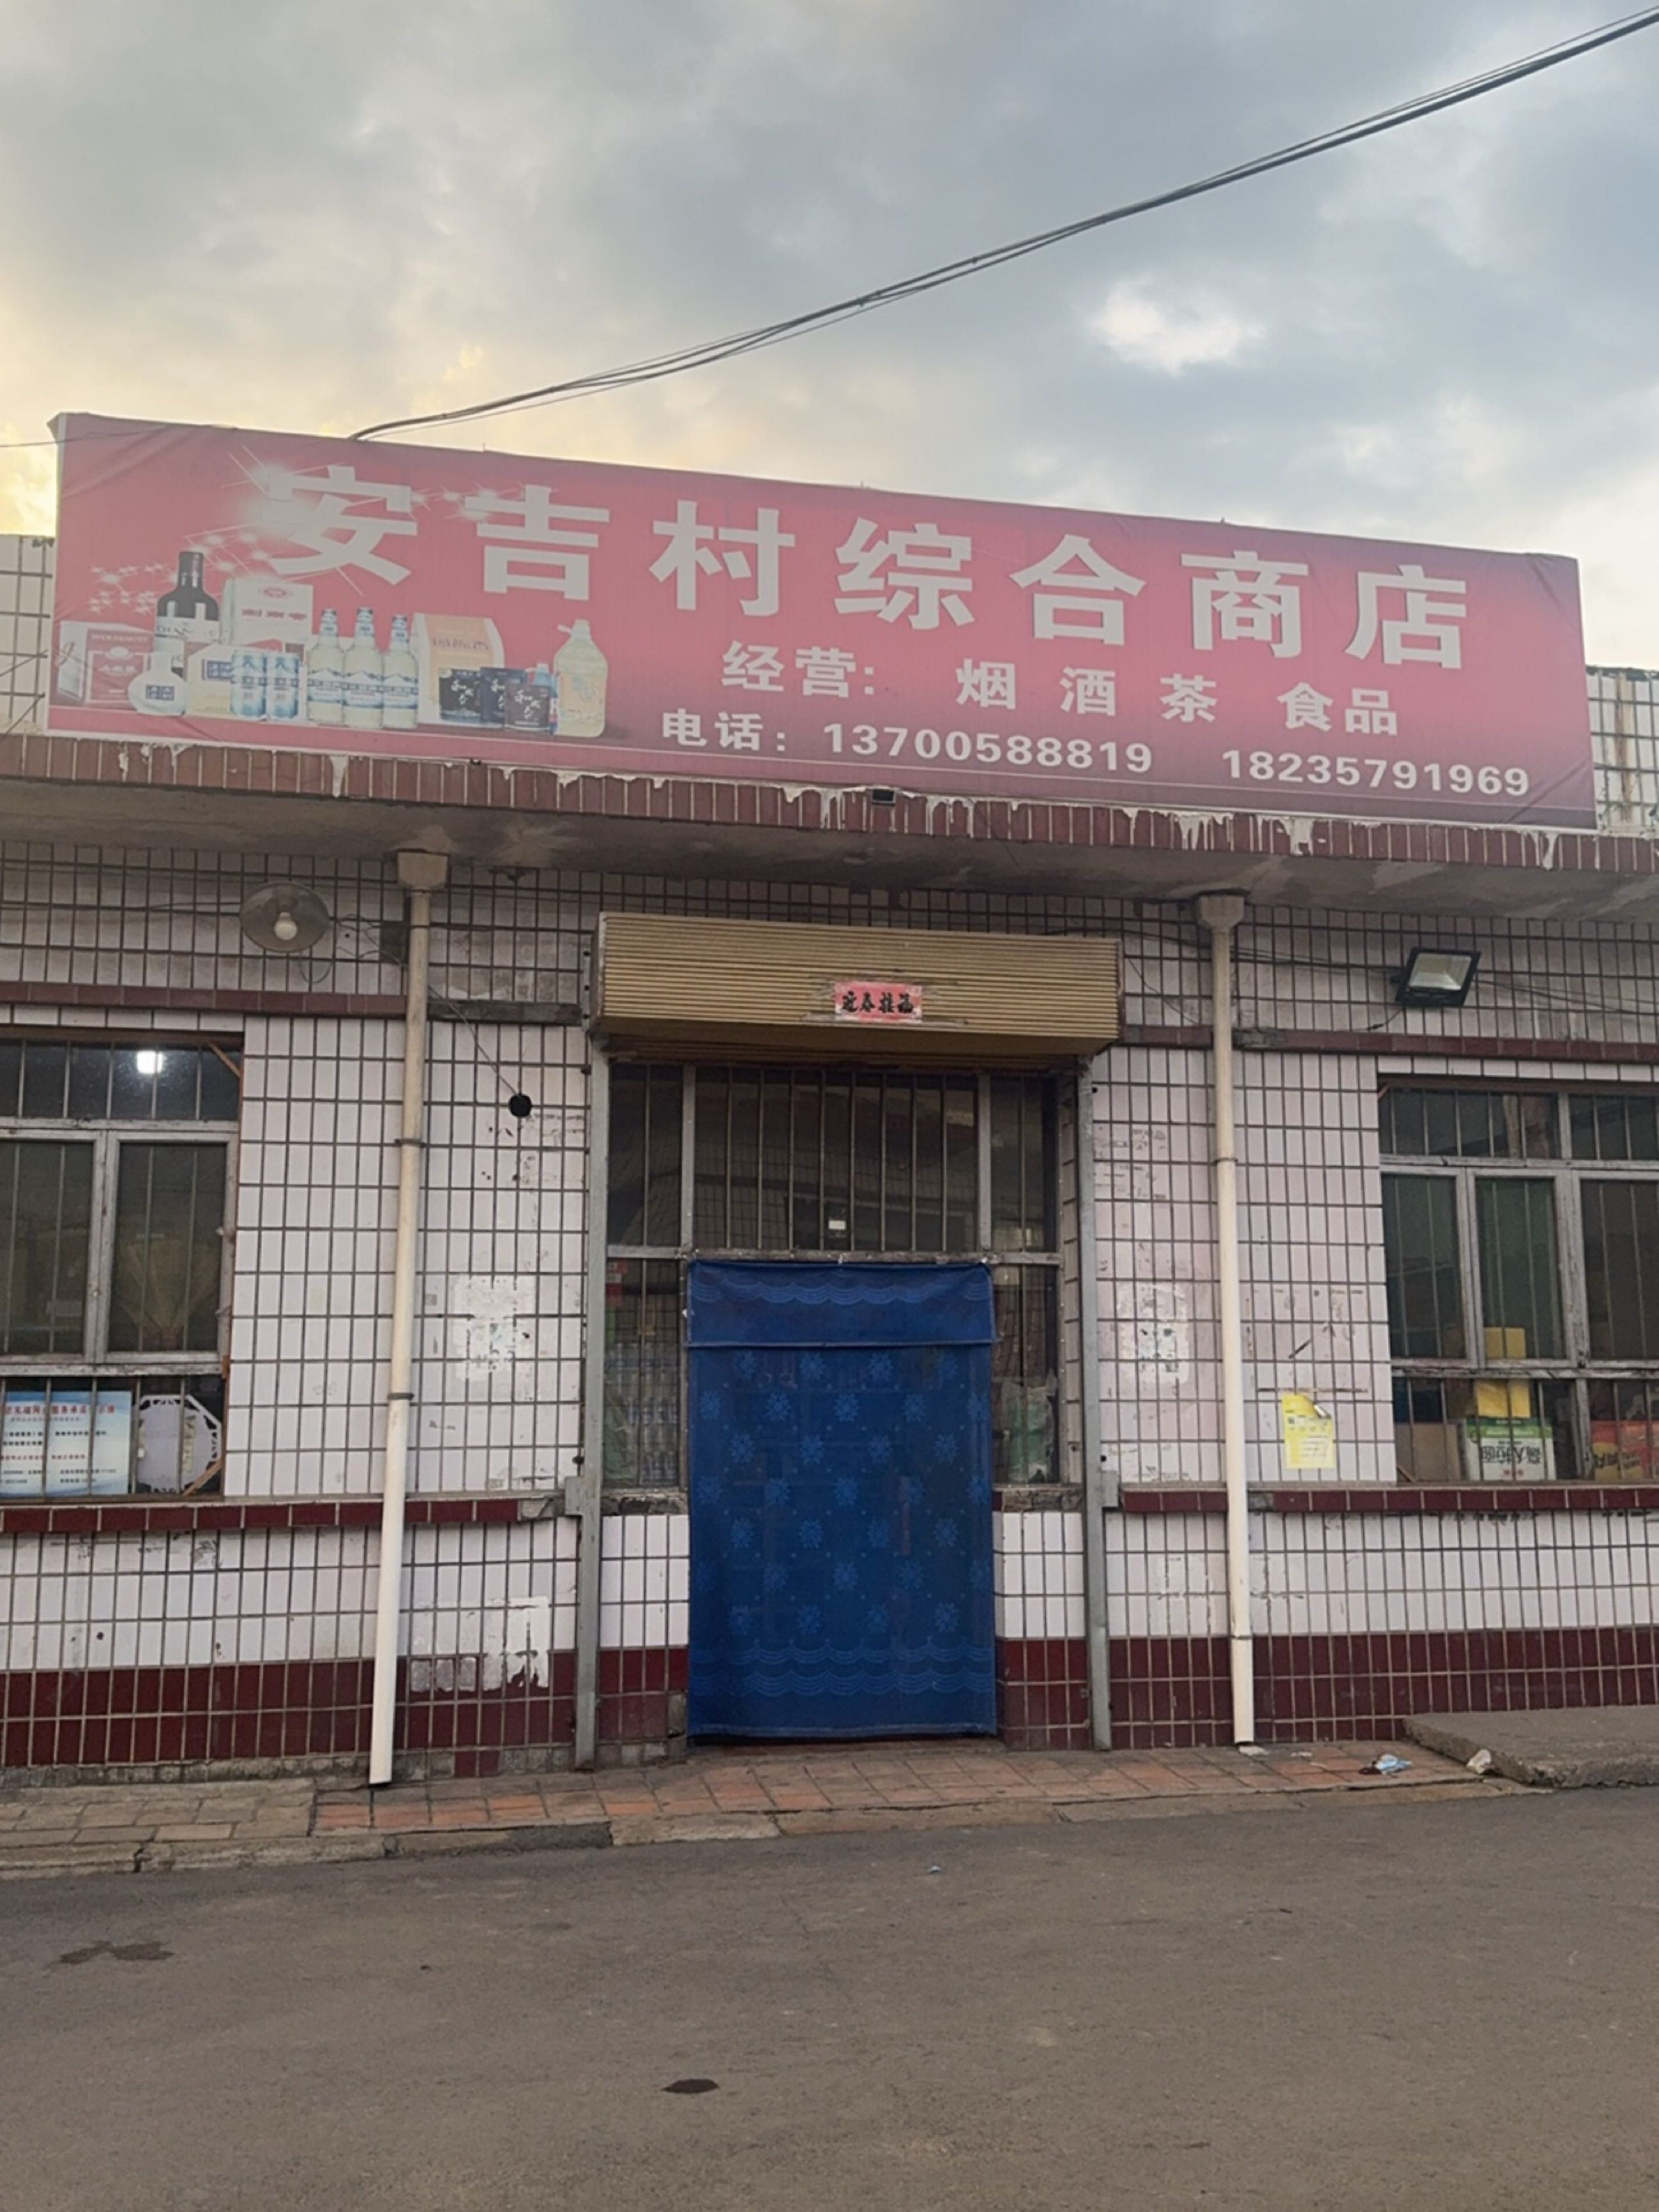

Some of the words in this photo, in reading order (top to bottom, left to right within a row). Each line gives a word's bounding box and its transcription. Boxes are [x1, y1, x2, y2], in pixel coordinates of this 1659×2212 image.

[262, 465, 1467, 669] 安吉村综合商店
[955, 658, 1016, 710] 烟
[1059, 666, 1116, 716] 酒
[1160, 673, 1218, 723] 茶
[1277, 682, 1398, 735] 食品
[824, 723, 1152, 773] 13700588819
[1222, 749, 1529, 796] 18235791969
